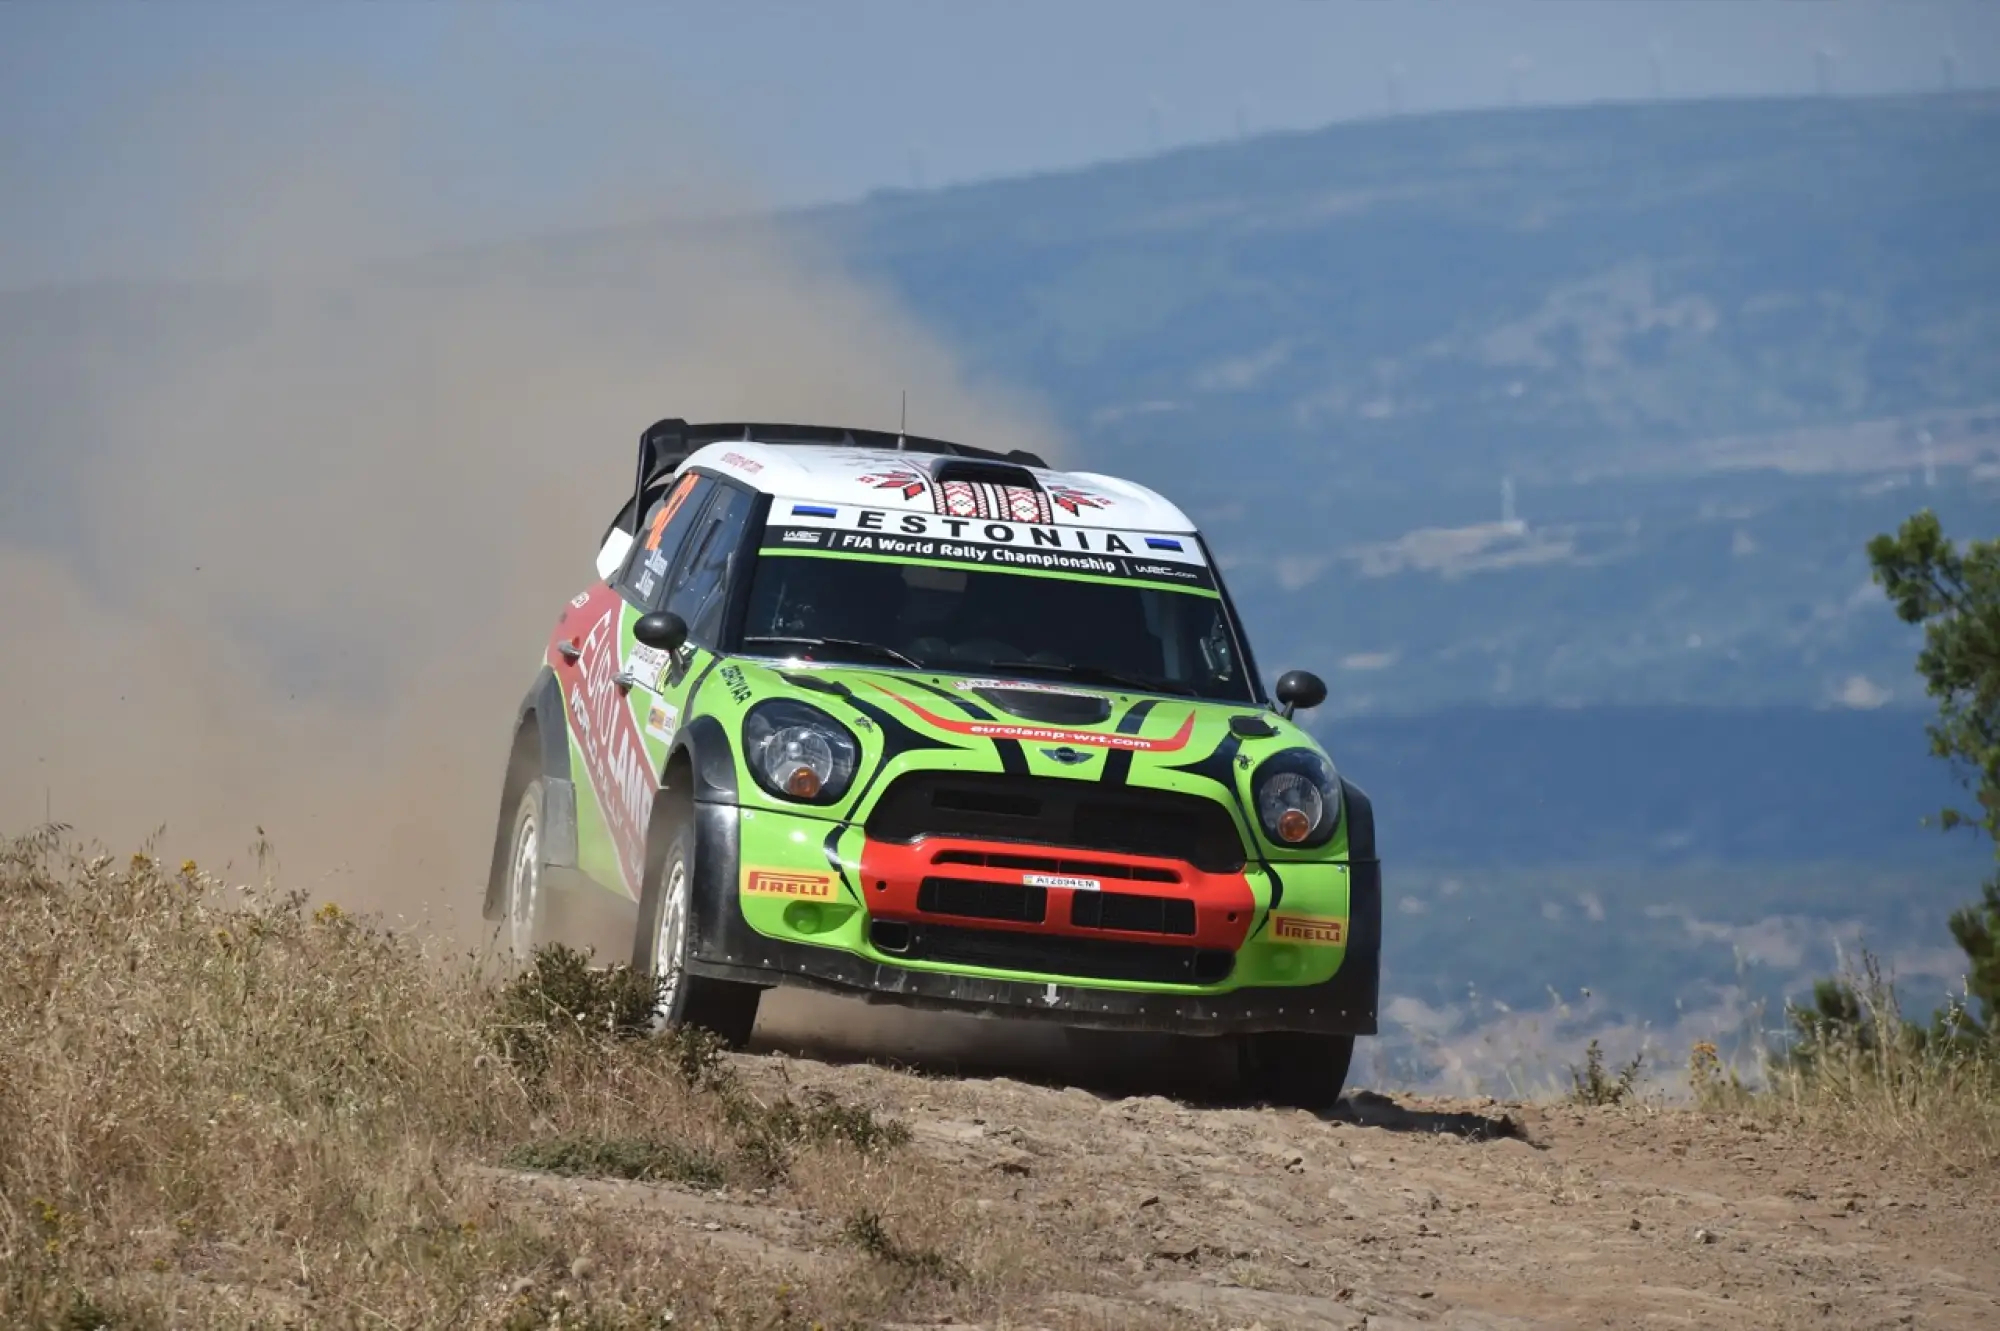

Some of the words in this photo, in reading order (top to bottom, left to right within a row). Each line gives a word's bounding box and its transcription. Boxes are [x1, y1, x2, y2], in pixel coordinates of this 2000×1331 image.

[857, 510, 1133, 554] ESTONIA
[842, 535, 873, 549] FIA
[878, 538, 933, 554] World
[940, 543, 987, 561] Rally
[993, 549, 1117, 573] Championship
[970, 724, 1151, 748] eurolamp-wrt.com
[747, 871, 830, 896] PIRELLI
[1275, 916, 1341, 943] PIRELLI
